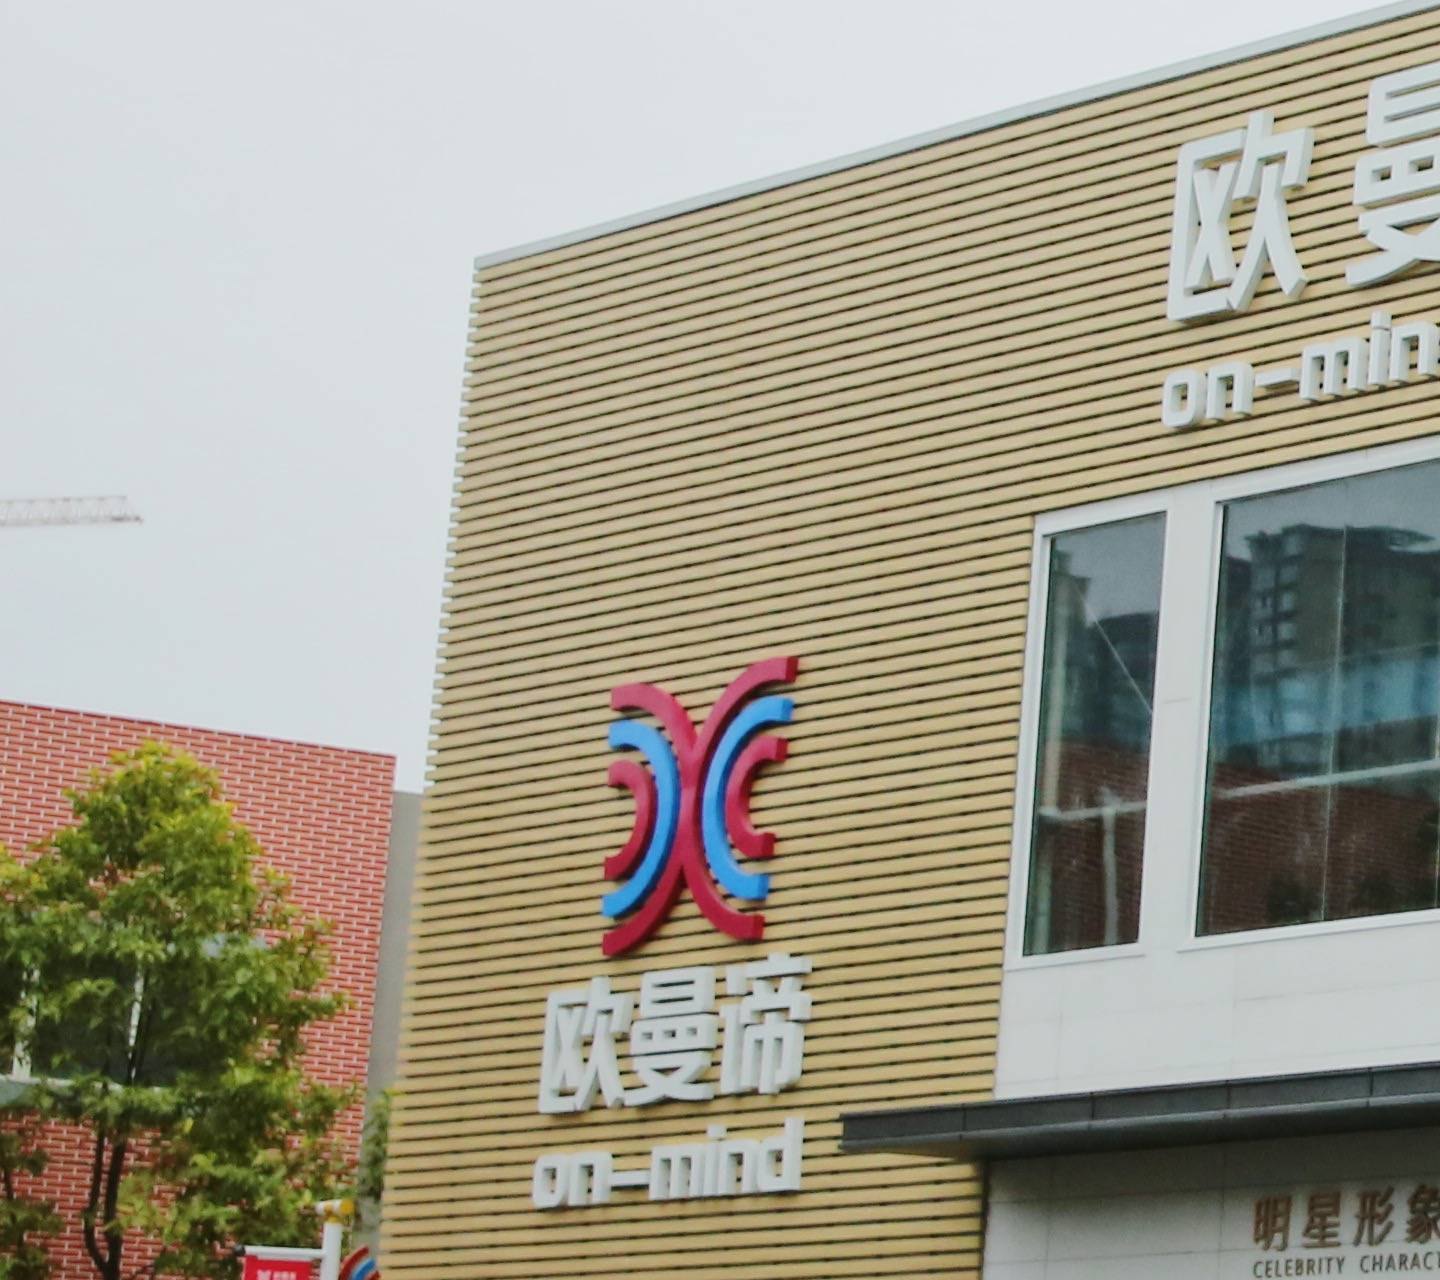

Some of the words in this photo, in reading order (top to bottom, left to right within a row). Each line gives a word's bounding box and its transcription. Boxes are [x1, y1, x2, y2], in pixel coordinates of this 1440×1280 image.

[538, 952, 813, 1114] 欧曼谛
[531, 1116, 806, 1209] on-mind
[1252, 1255, 1346, 1280] CELEBRITY
